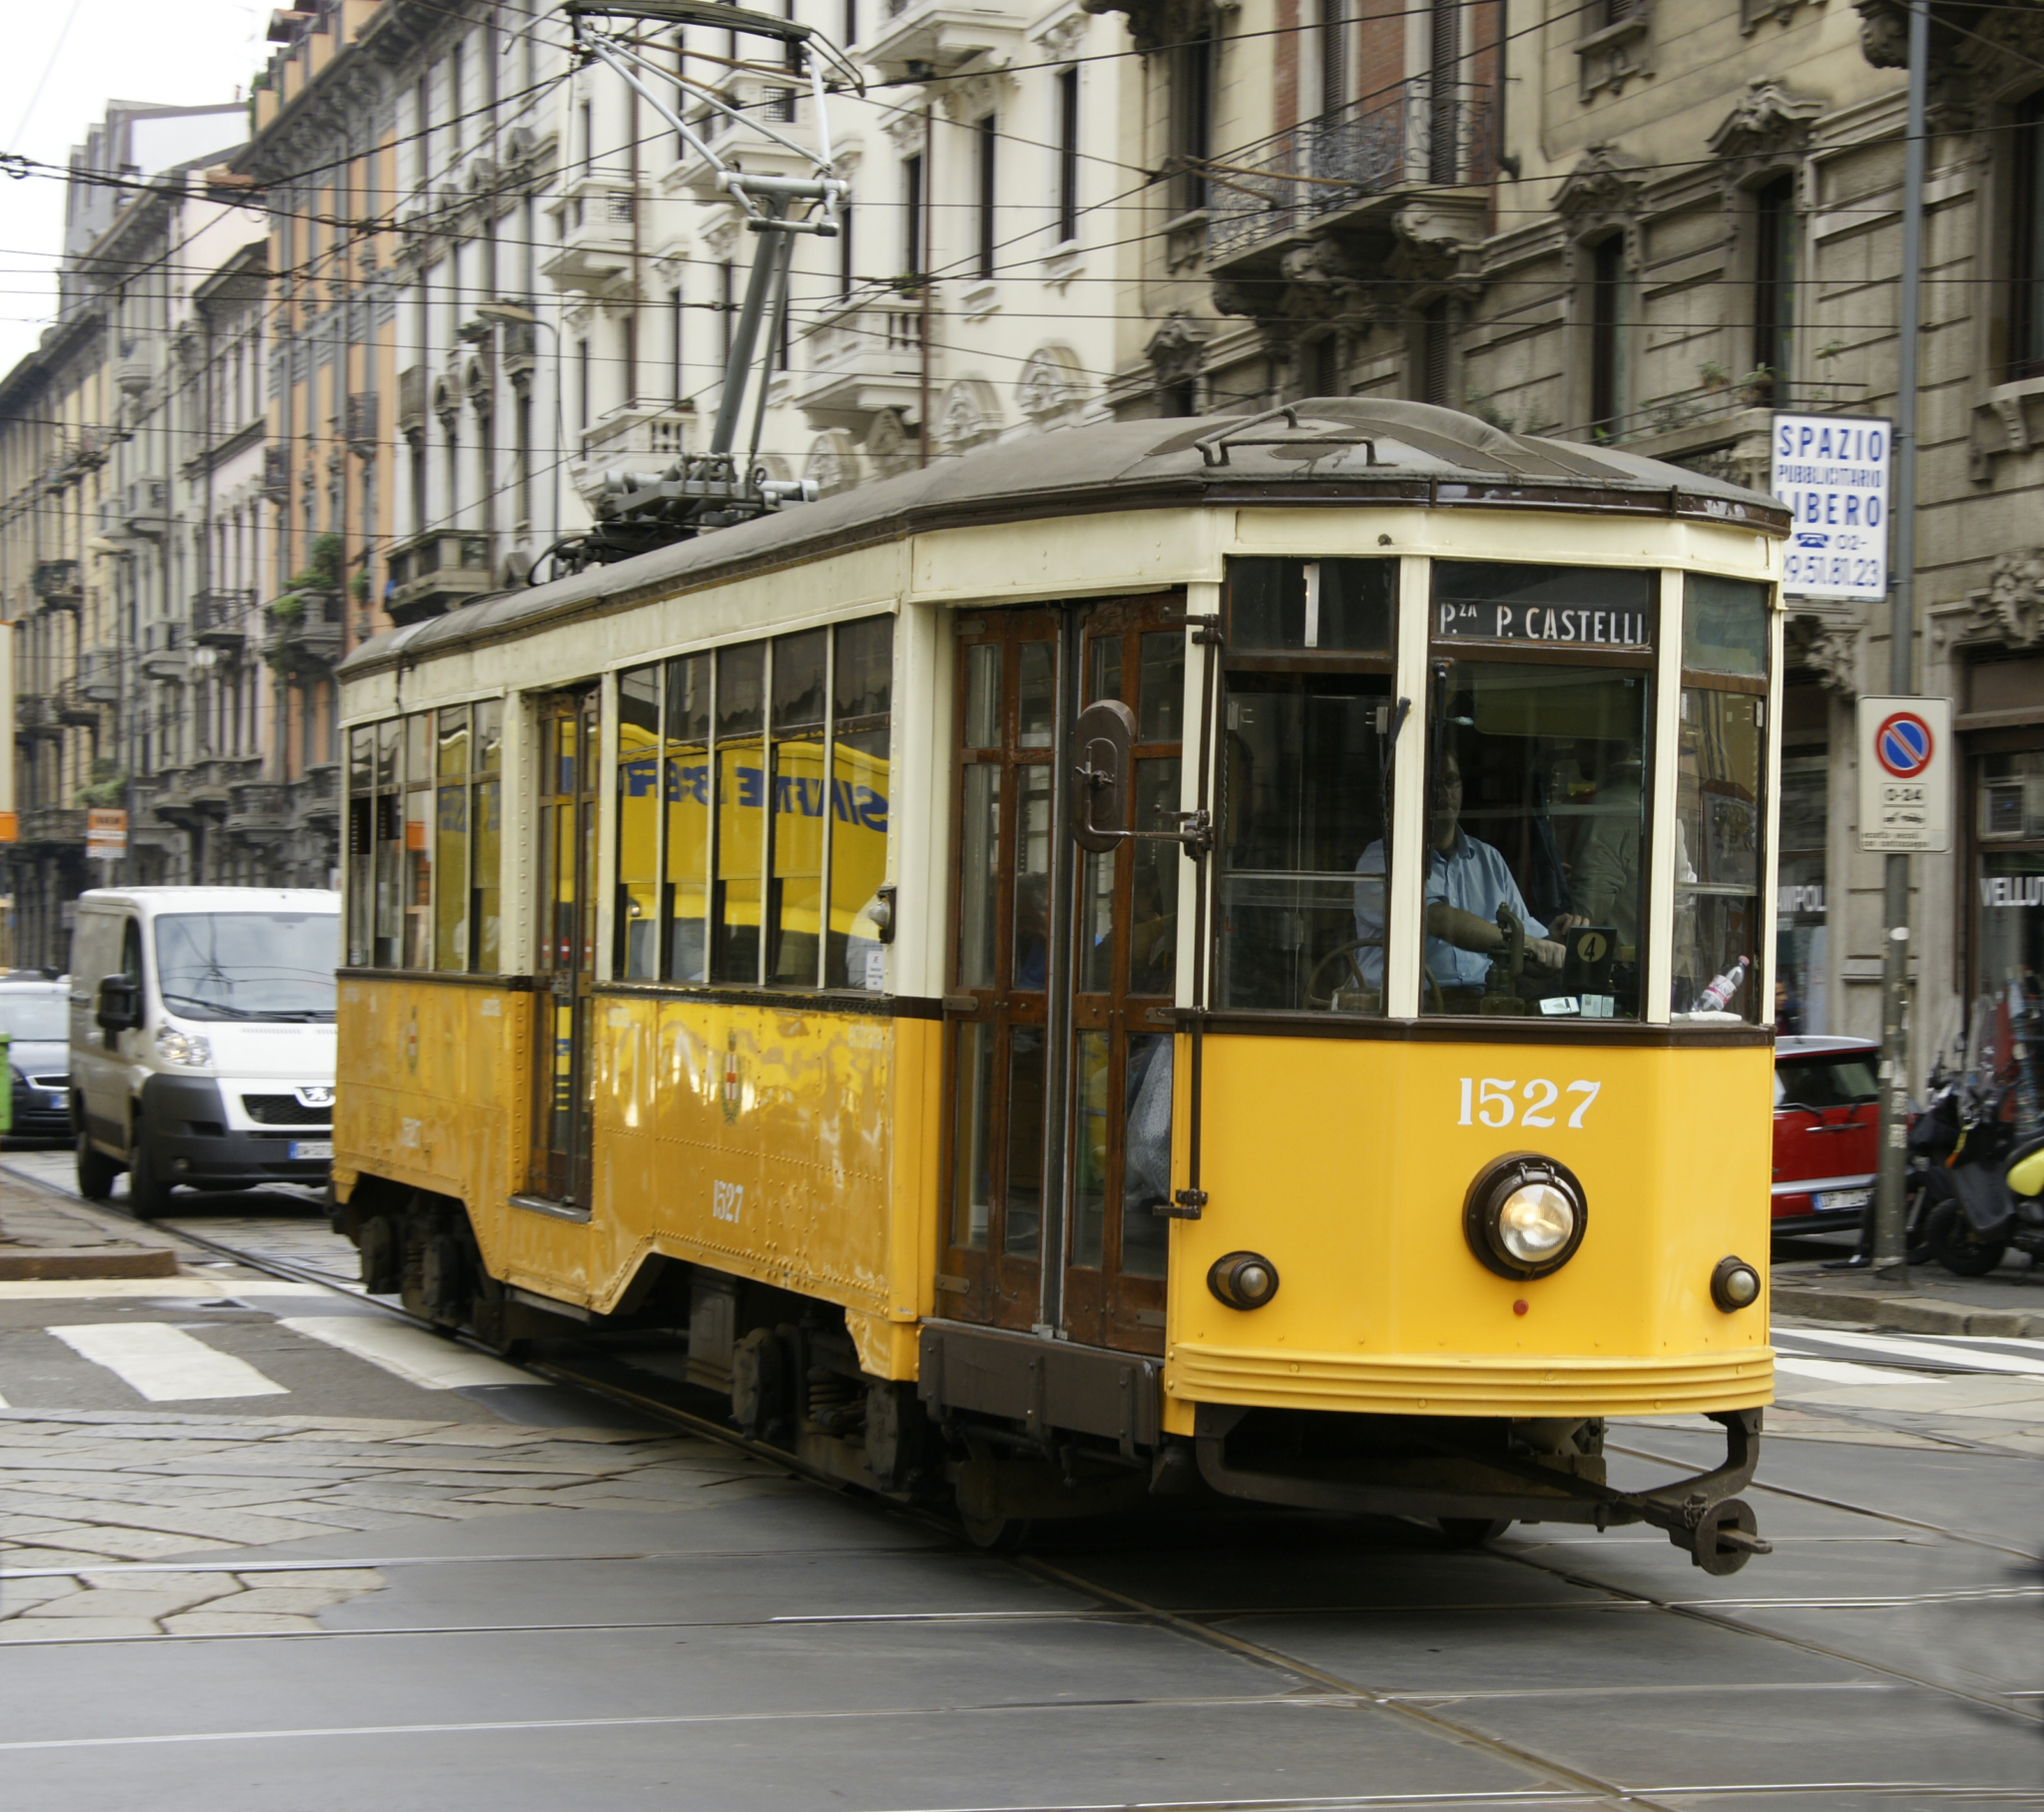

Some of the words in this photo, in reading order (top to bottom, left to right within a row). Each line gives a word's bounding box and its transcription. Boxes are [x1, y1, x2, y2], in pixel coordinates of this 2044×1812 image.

[1779, 425, 1882, 462] SPAZIO
[1302, 562, 1320, 648] 1
[1497, 605, 1513, 638] P.
[1525, 607, 1643, 645] CASTELLI
[1584, 936, 1596, 962] 4
[1457, 1078, 1601, 1129] 1527
[713, 1179, 745, 1224] 1527
